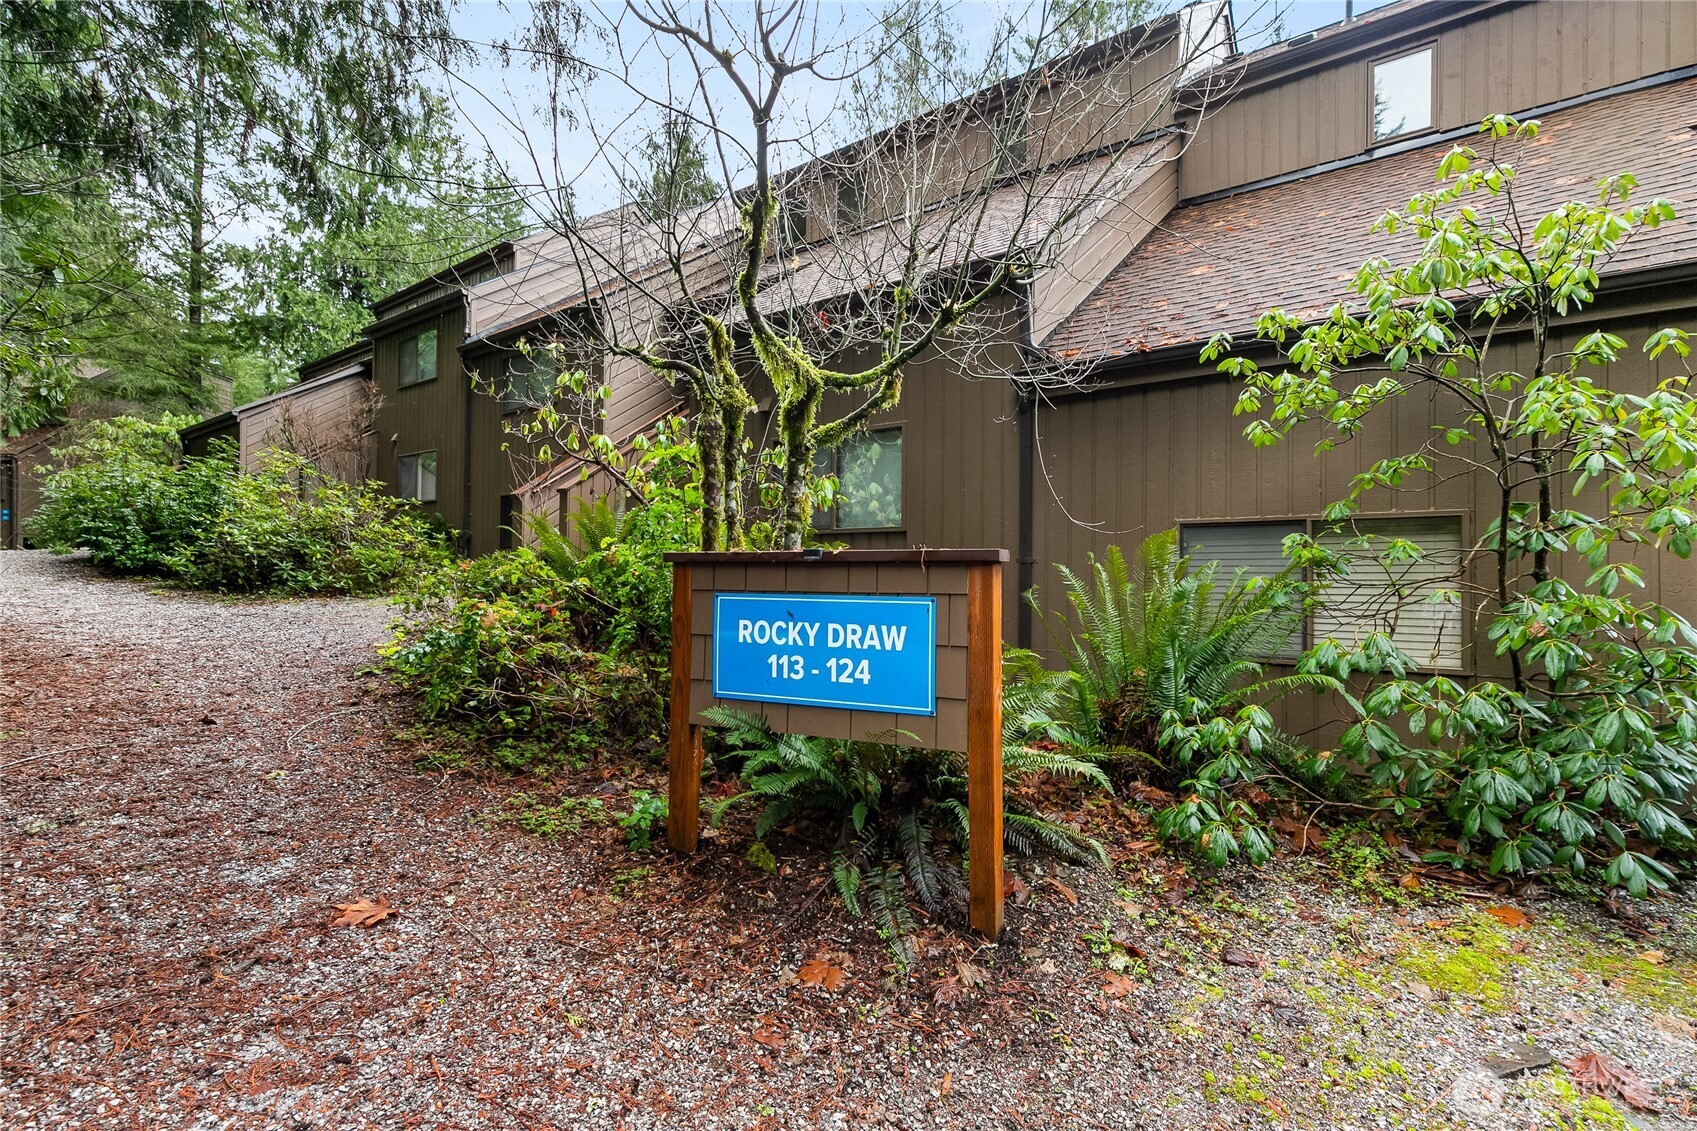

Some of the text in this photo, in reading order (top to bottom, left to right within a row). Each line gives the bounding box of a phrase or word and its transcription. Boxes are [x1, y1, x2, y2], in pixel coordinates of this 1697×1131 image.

[738, 619, 907, 651] ROCKY DRAW
[767, 654, 804, 680] 113
[825, 657, 871, 685] 124
